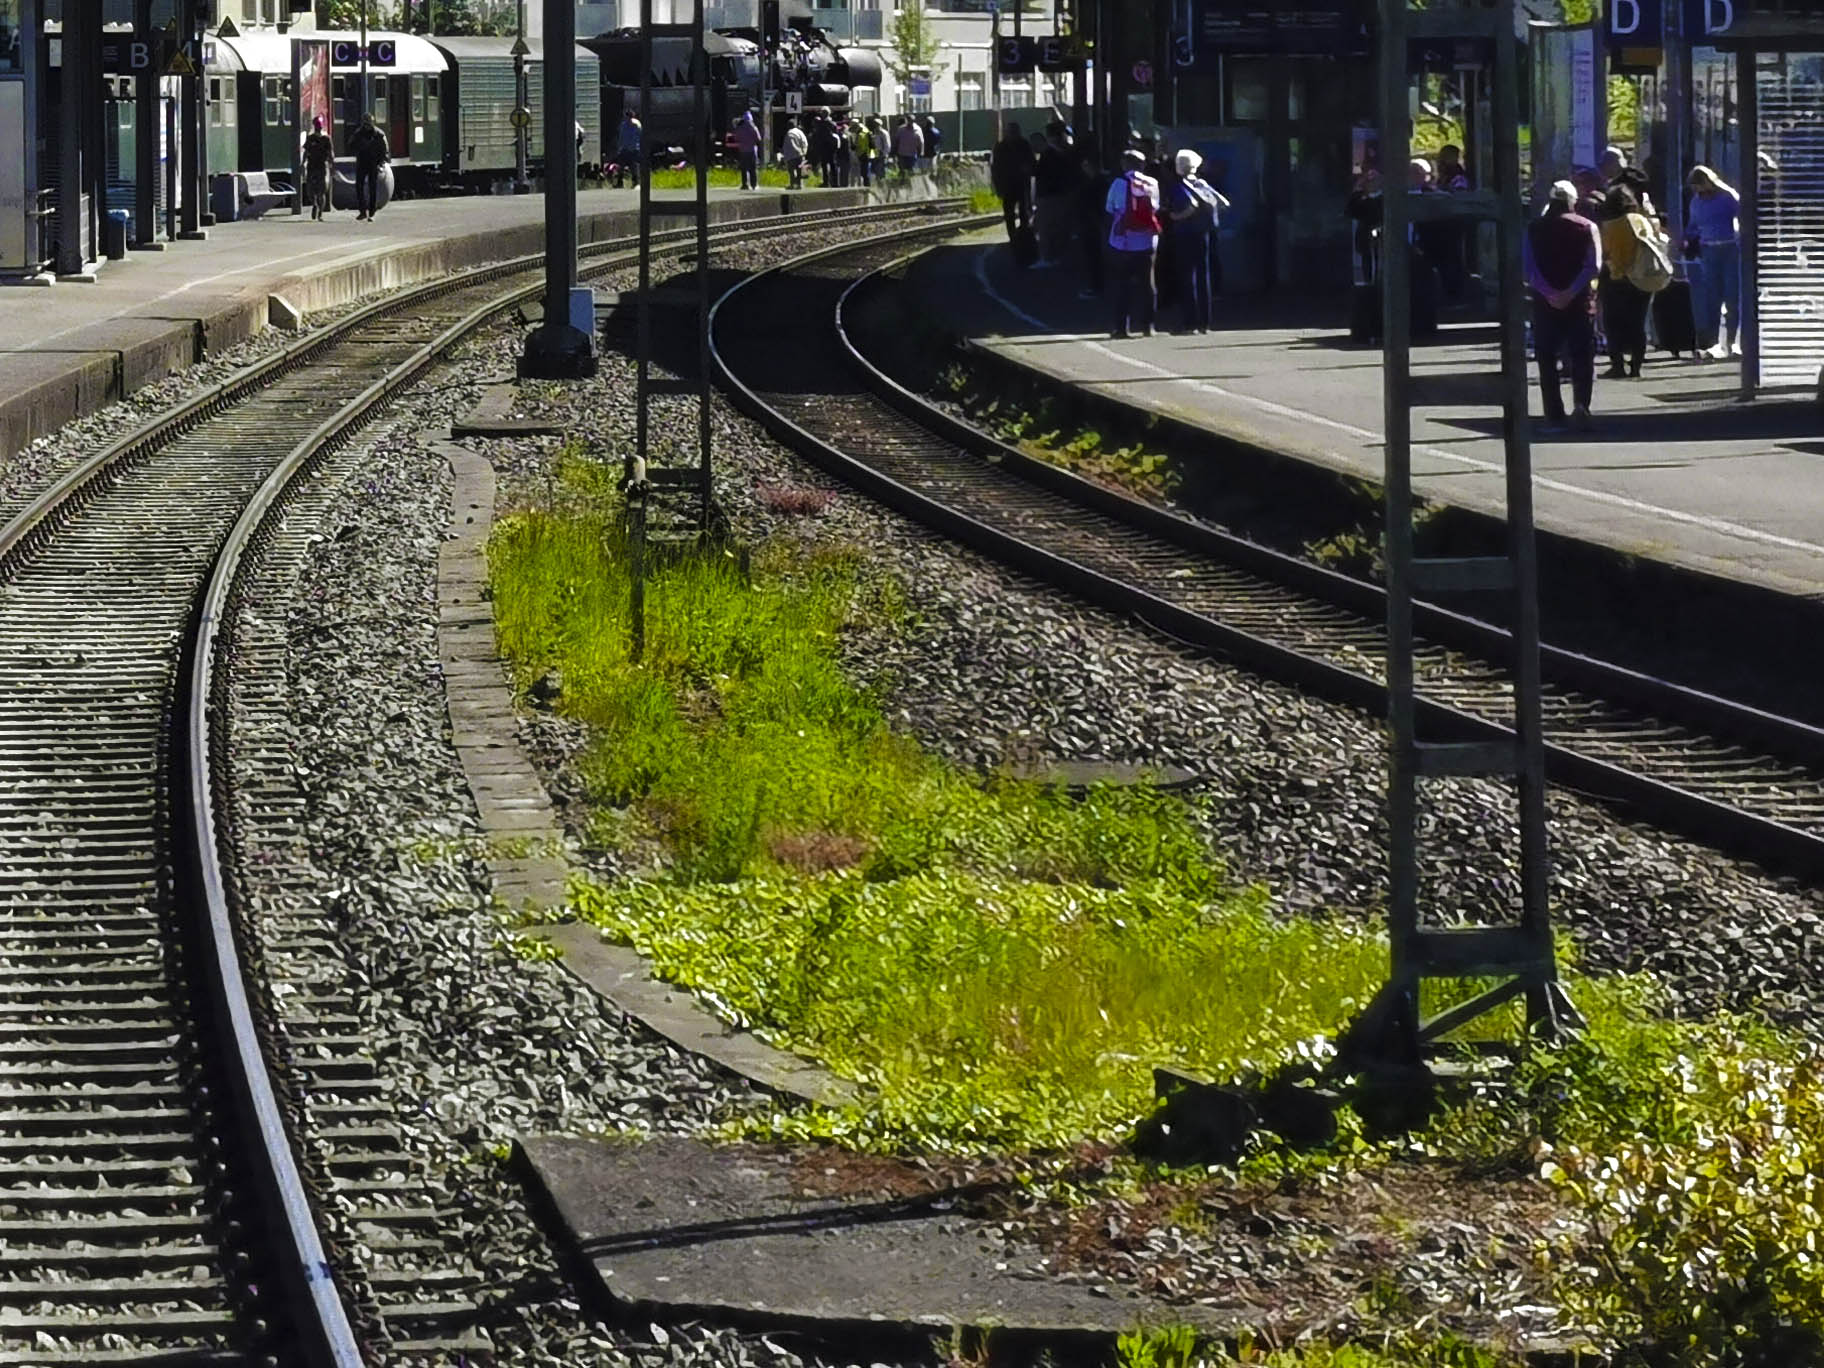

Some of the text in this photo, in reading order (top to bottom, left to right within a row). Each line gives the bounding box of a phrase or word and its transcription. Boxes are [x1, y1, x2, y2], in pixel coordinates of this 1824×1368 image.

[130, 42, 149, 68] B
[335, 42, 349, 61] C
[378, 42, 393, 61] C
[790, 94, 797, 111] 4
